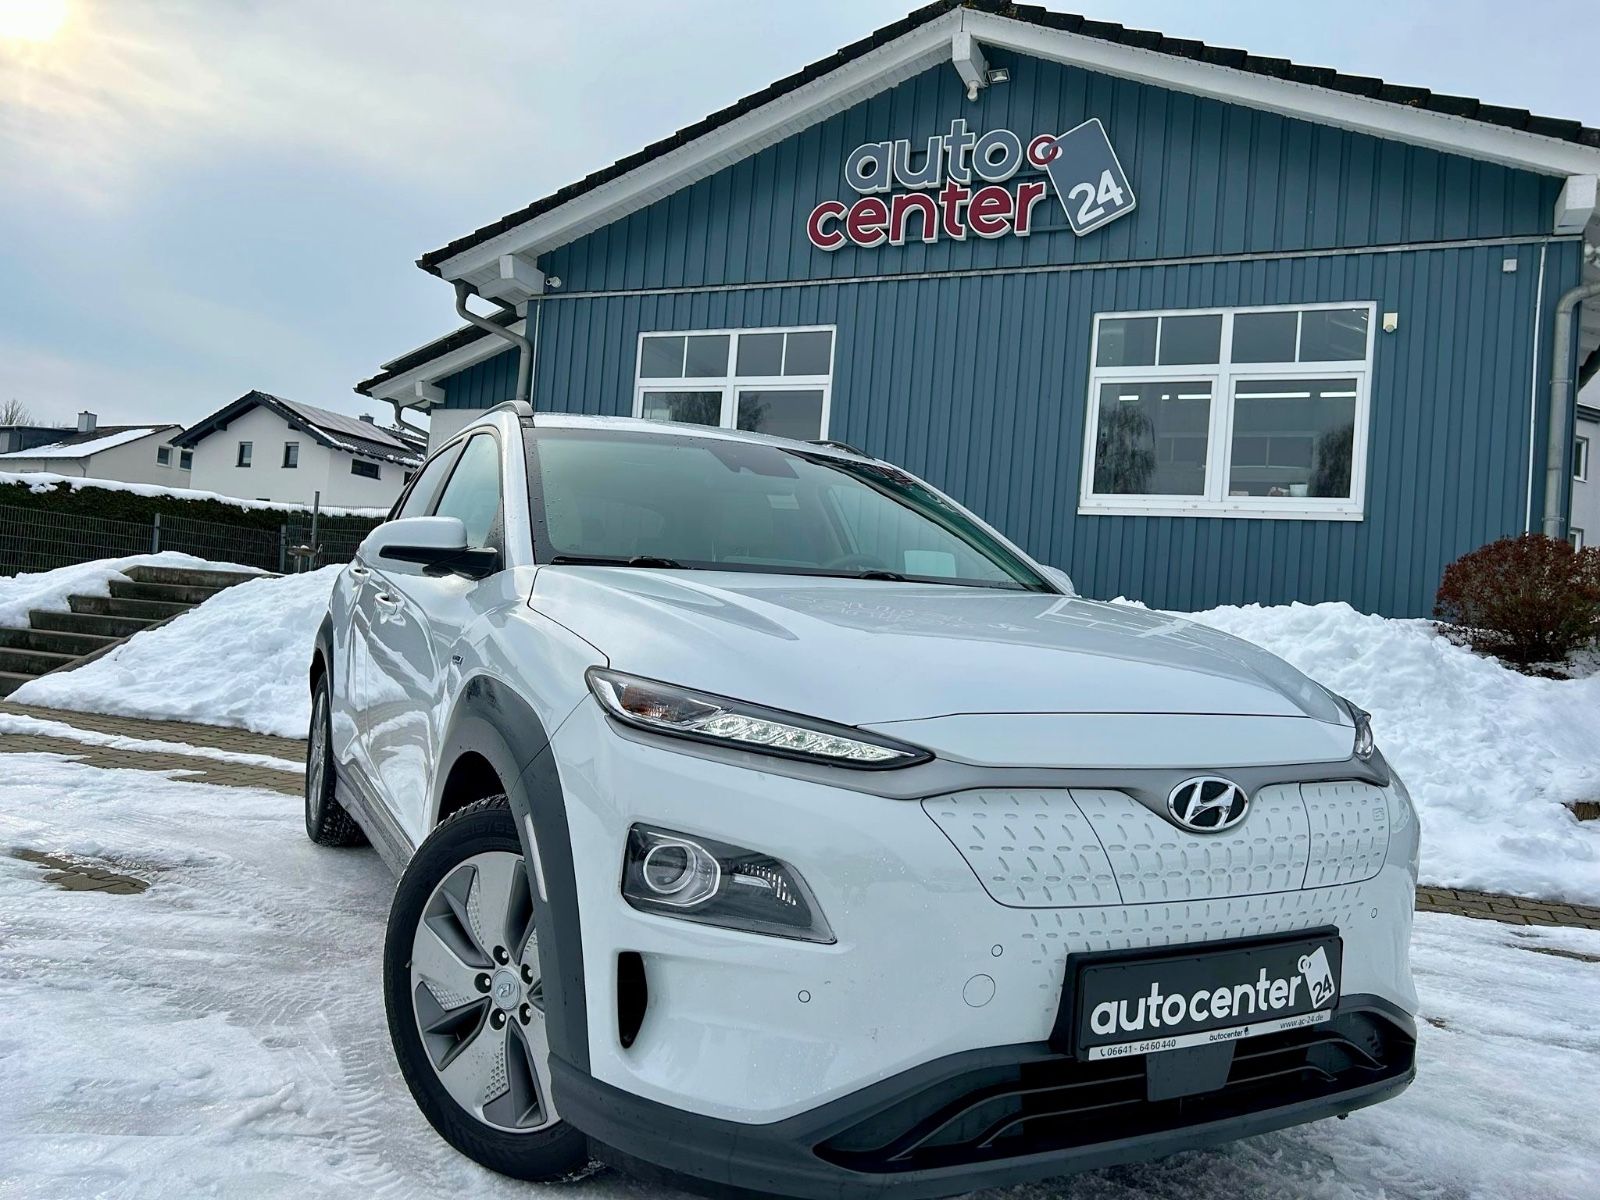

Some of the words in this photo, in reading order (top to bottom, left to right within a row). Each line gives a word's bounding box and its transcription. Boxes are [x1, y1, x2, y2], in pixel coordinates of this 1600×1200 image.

[845, 119, 1023, 195] auto
[1068, 169, 1124, 226] 24
[806, 176, 1047, 252] center
[1312, 974, 1332, 1002] 24
[1209, 1029, 1243, 1041] autocenter
[1280, 1015, 1324, 1029] www.ac-24.de
[1107, 1045, 1132, 1057] 06641
